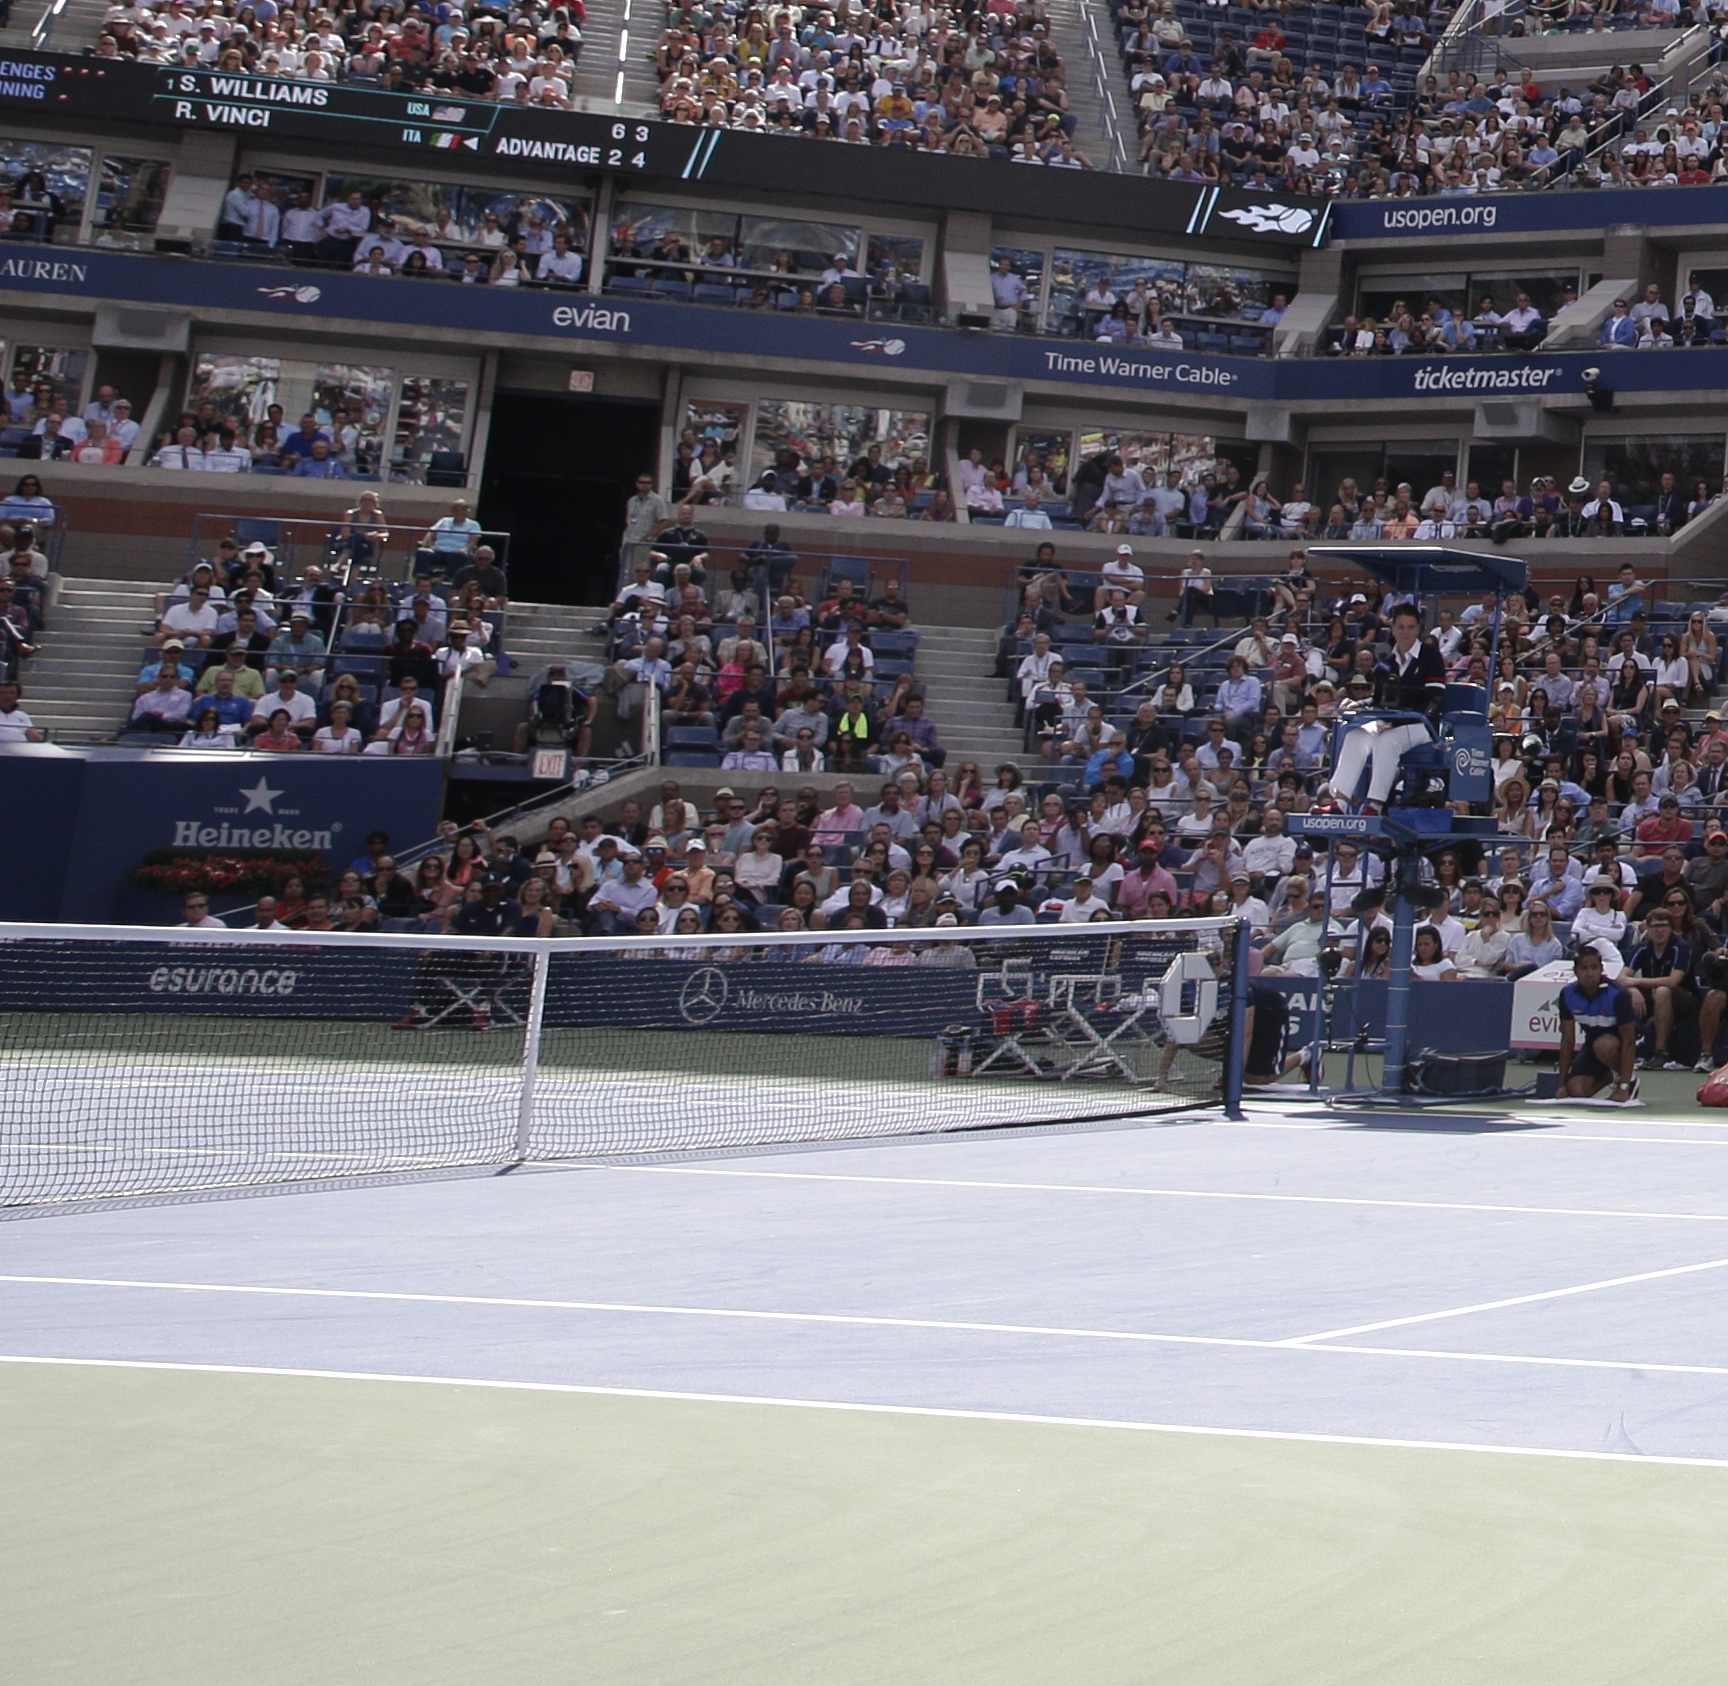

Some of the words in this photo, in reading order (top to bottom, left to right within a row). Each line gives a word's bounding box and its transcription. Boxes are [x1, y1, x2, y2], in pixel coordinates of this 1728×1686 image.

[166, 79, 174, 90] 1
[179, 75, 201, 93] S.
[211, 77, 329, 106] WILLIAMS
[175, 101, 197, 119] R.
[206, 104, 271, 127] VINCI
[407, 101, 431, 117] USA
[402, 129, 422, 143] ITA
[611, 123, 625, 139] 6
[635, 126, 649, 142] 3
[496, 137, 601, 164] ADVANTAGE
[608, 149, 622, 165] 2
[632, 152, 646, 168] 4
[1383, 205, 1497, 231] usopen.org
[1, 257, 88, 282] AUREN
[552, 303, 631, 332] evian
[1045, 352, 1095, 376] Time
[1098, 355, 1171, 380] Warner
[1176, 362, 1232, 386] Cable
[1413, 365, 1555, 390] ticketmaster
[172, 821, 333, 850] Heineken
[1303, 818, 1366, 831] usopen.org
[149, 966, 299, 996] esurance
